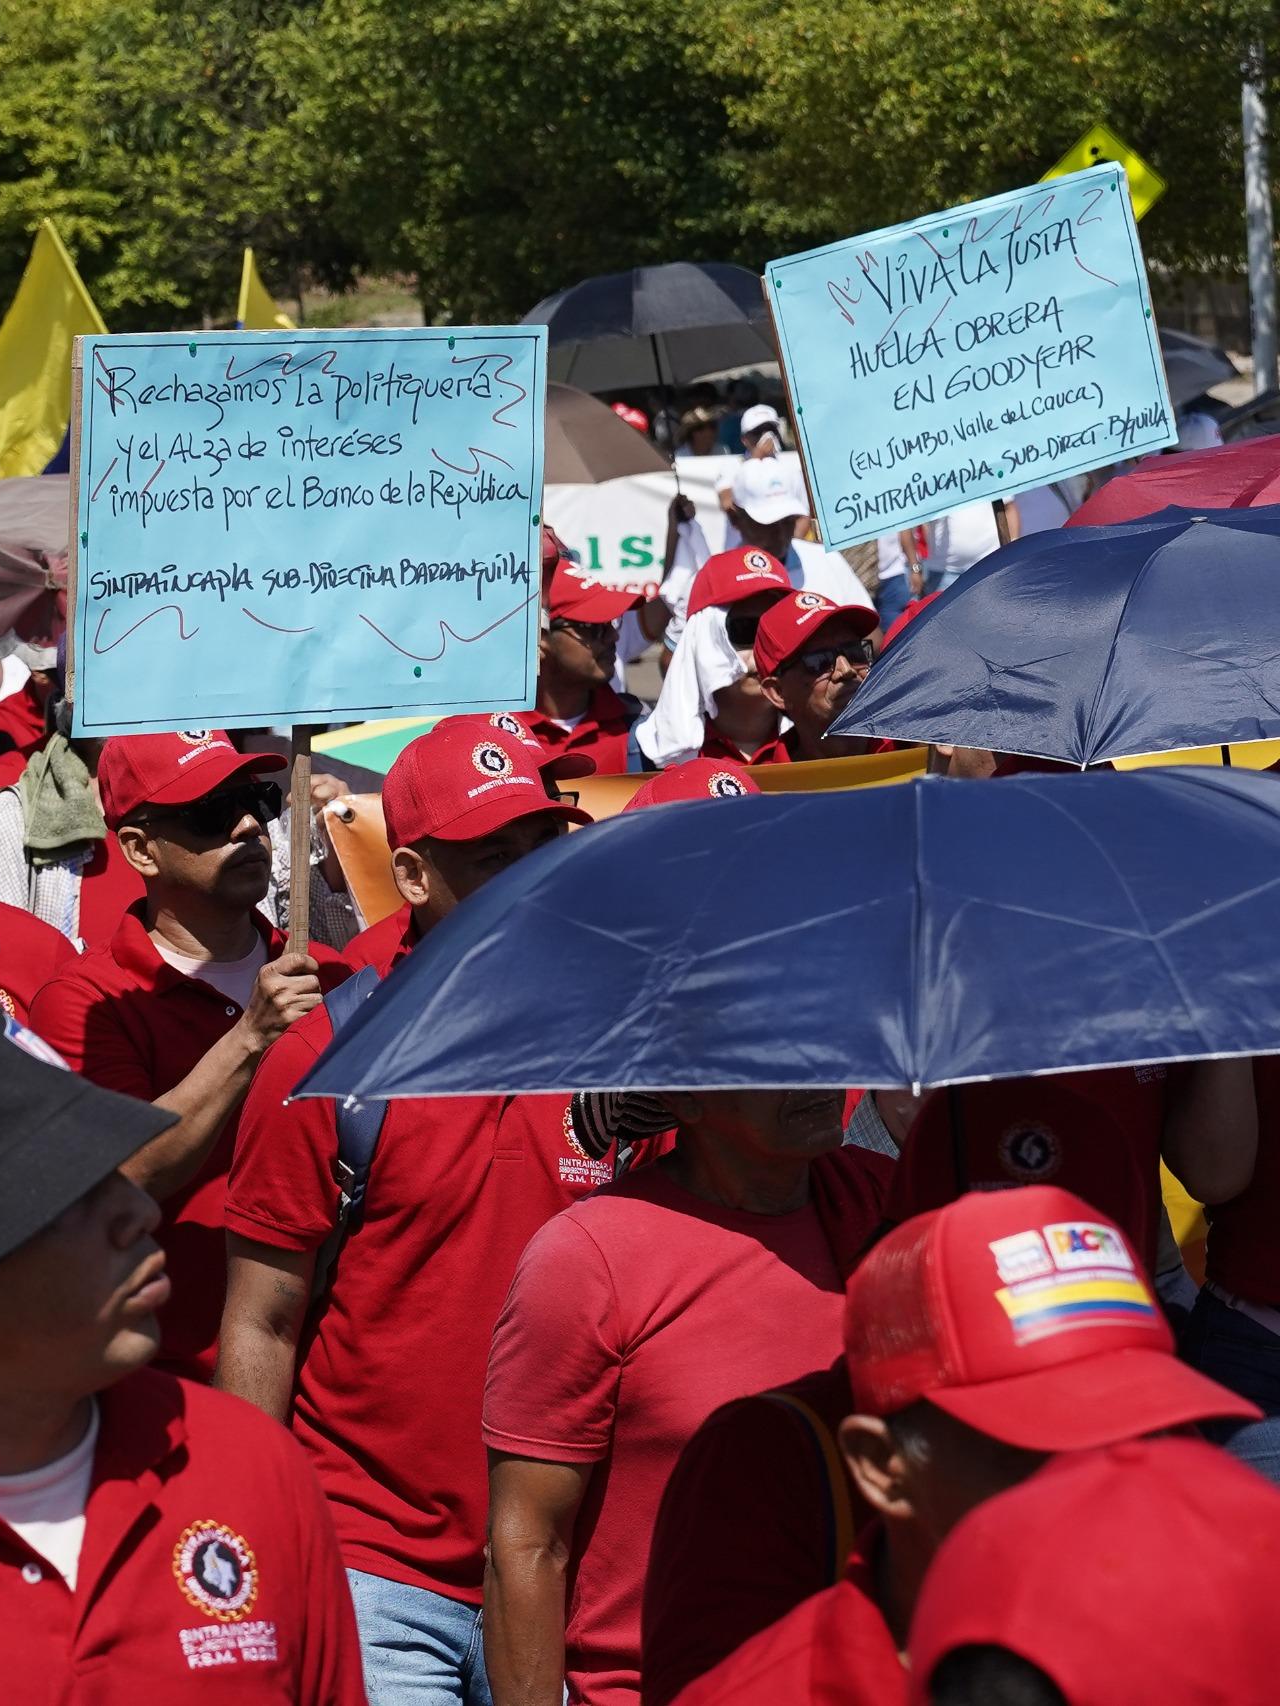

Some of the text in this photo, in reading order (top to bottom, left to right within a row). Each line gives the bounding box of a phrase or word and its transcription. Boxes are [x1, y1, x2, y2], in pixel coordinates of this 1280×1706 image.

[955, 295, 1064, 352] OBRERA
[108, 365, 287, 432] Rechazamos
[894, 334, 1096, 411] EN GOODYEAR
[238, 431, 267, 460] de
[109, 470, 530, 532] impuesta por el Banco de la República
